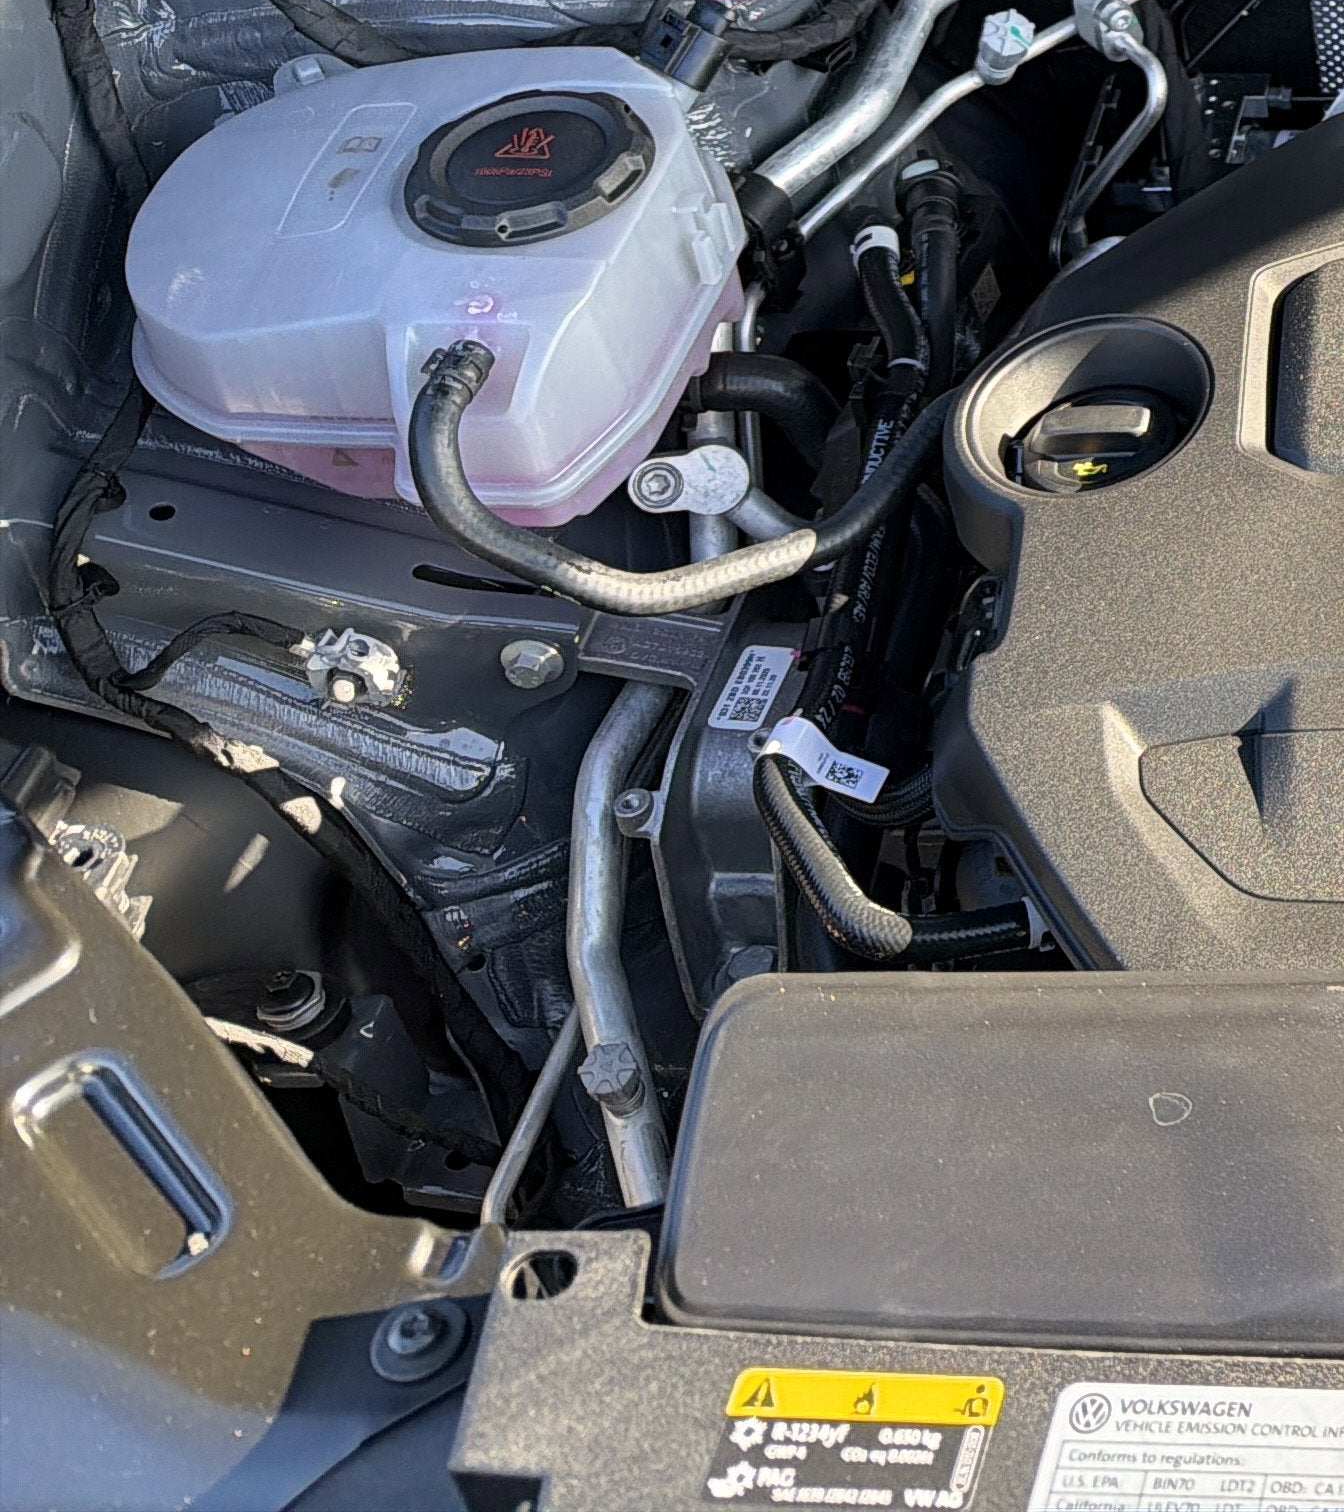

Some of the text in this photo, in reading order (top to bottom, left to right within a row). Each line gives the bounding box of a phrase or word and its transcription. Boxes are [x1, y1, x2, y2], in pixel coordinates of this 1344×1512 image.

[1120, 1398, 1252, 1418] VOLKSWAGEN
[1115, 1420, 1171, 1434] VEHICLE
[1177, 1421, 1248, 1436] EMISSION
[1251, 1423, 1317, 1438] CONTROL
[1069, 1448, 1137, 1463] Conforms
[1142, 1451, 1157, 1463] to
[1063, 1475, 1086, 1488] U.S.
[1093, 1476, 1119, 1488] EPA
[1153, 1477, 1196, 1491] BIN70
[1220, 1478, 1256, 1493] LDT2
[1314, 1482, 1335, 1496] CA
